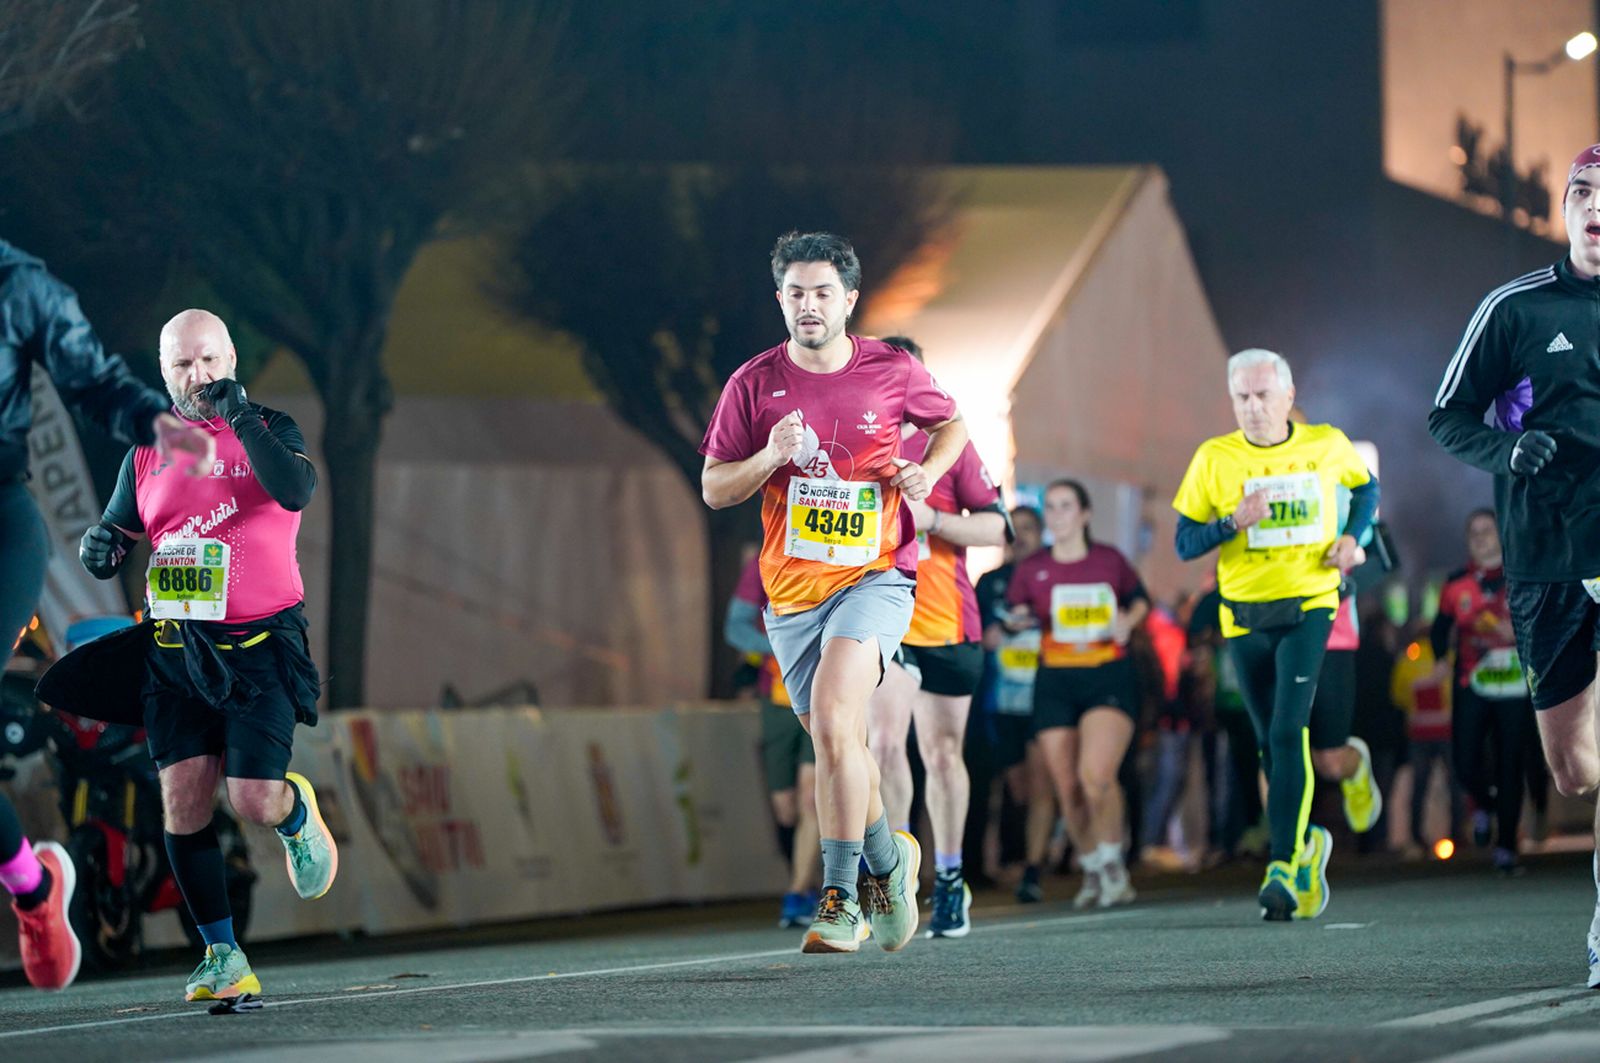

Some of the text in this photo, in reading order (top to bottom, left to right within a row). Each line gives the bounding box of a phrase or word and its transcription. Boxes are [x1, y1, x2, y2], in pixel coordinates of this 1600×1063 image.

[1546, 342, 1574, 353] adidas
[804, 456, 829, 478] 43
[810, 489, 851, 500] NOCHE DE
[798, 497, 818, 507] SAN
[804, 508, 865, 537] 4349
[187, 547, 196, 556] DE
[155, 557, 169, 566] SAN
[158, 567, 212, 592] 8886
